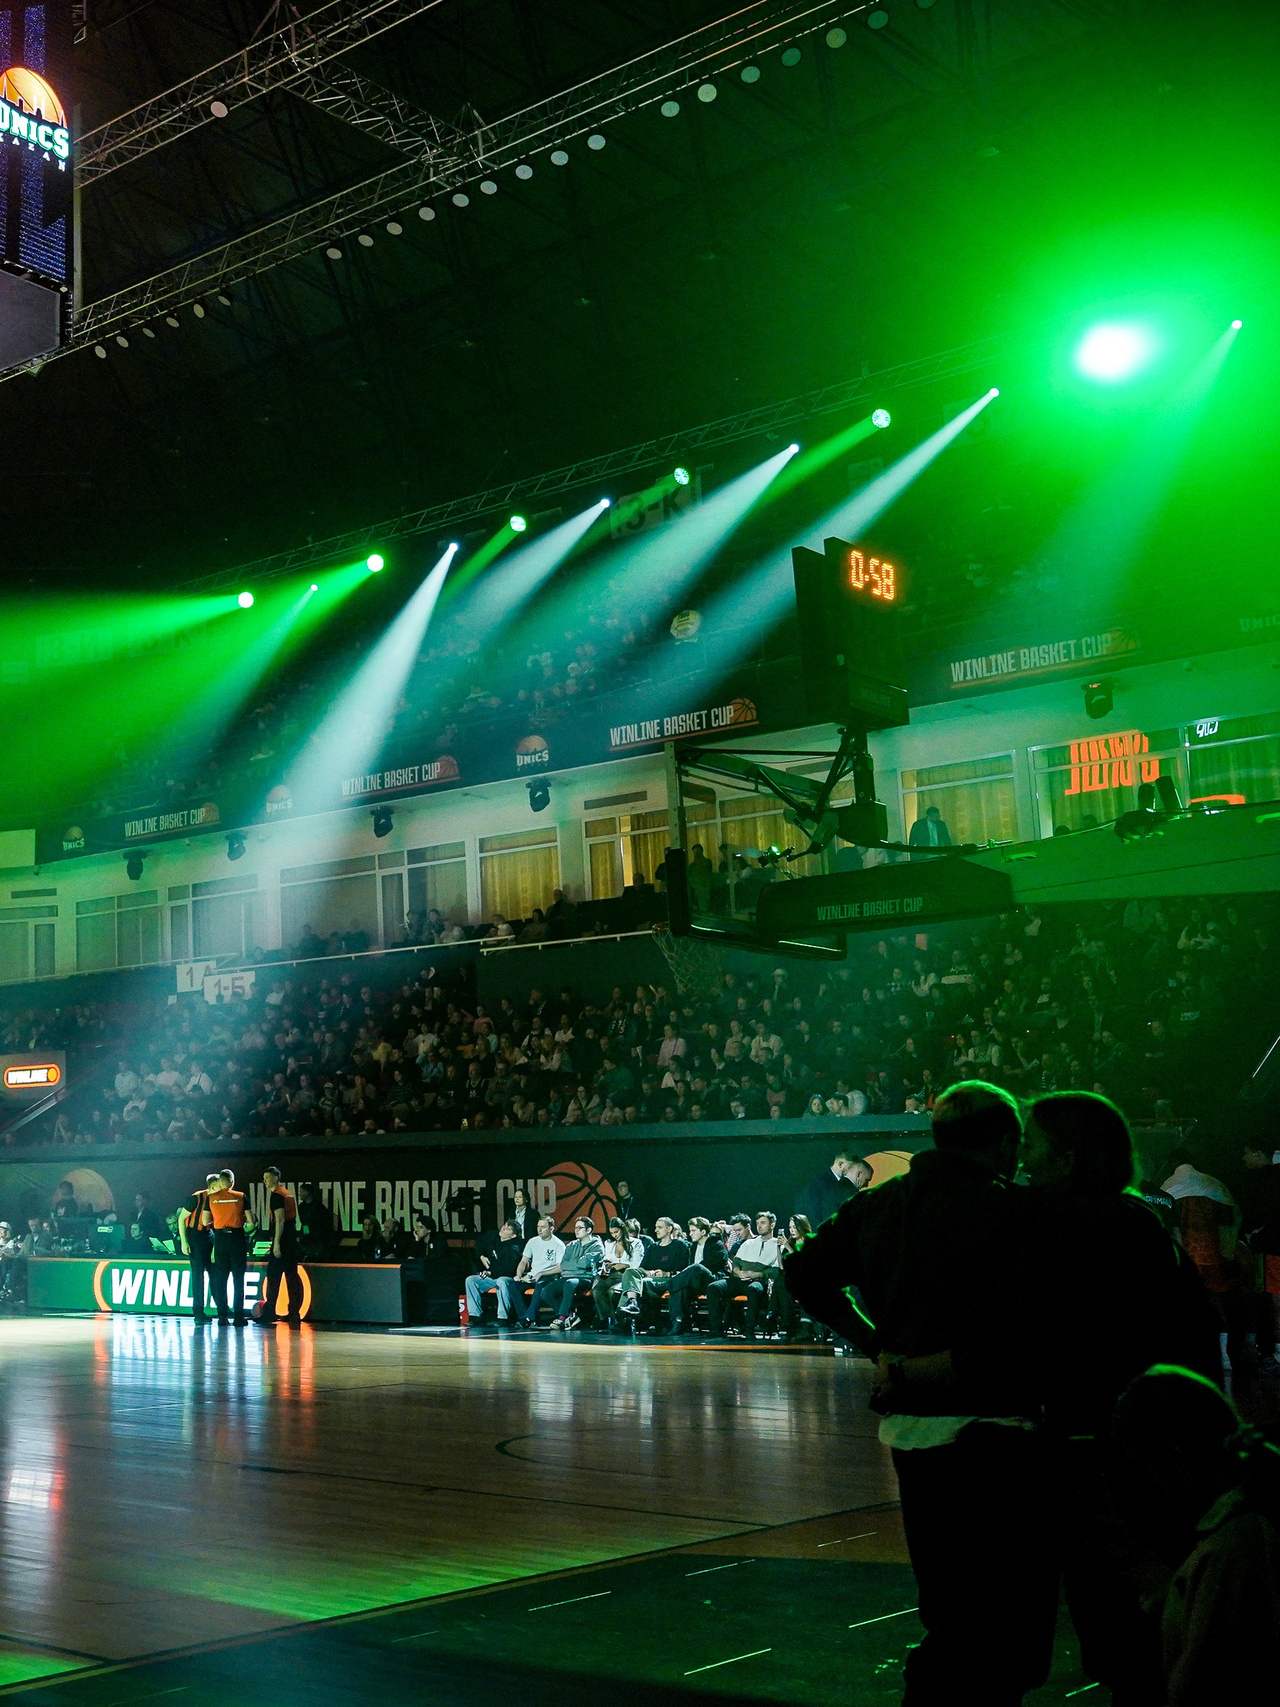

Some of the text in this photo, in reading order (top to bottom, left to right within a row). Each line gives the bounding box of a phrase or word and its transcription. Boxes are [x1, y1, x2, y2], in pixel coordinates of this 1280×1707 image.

[950, 633, 1111, 683] WINLINE BASKET CUP
[609, 705, 735, 747] WINLINE BASKET CUP
[516, 749, 549, 768] UNICS
[341, 762, 441, 797] WINLINE BASKET CUP
[124, 807, 206, 838] WINLINE BASKET CUP
[62, 838, 85, 852] UNICS
[817, 897, 924, 921] WINLINE BASKET CUP
[7, 1068, 48, 1084] WINLINE
